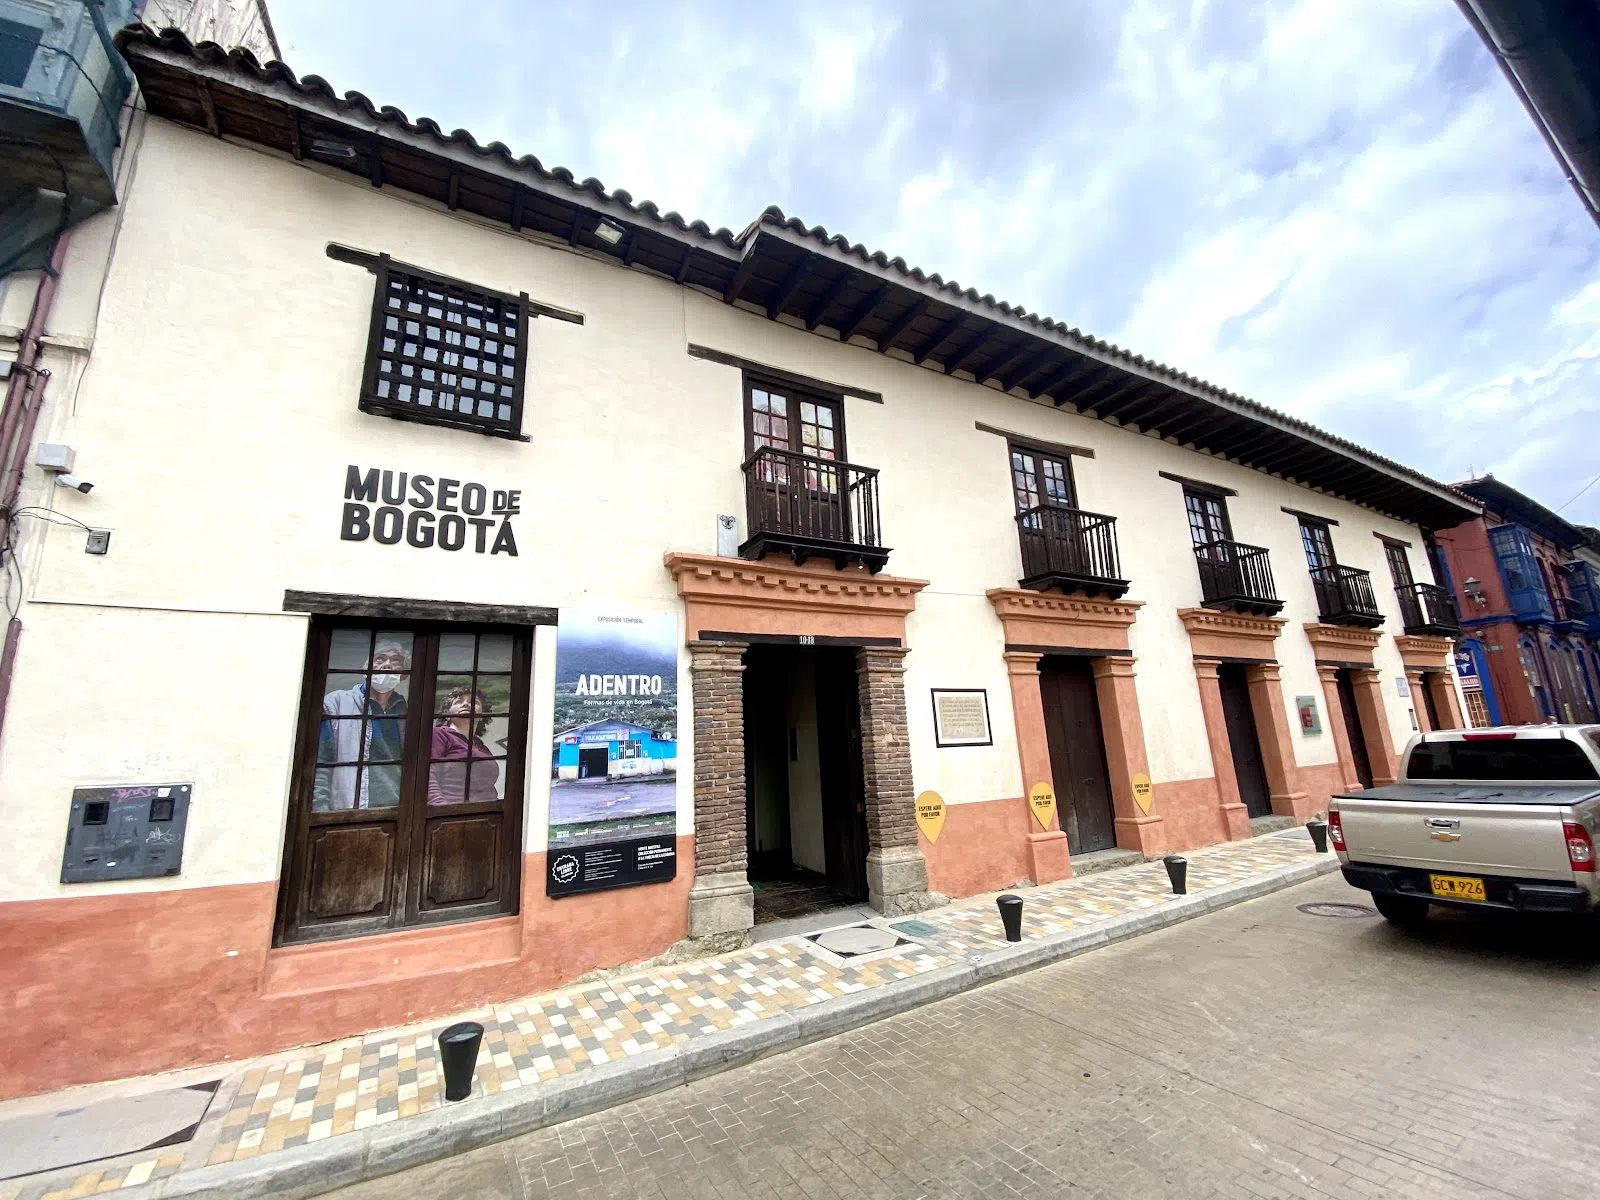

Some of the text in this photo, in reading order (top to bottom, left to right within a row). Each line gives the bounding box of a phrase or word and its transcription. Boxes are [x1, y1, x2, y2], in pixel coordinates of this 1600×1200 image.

[344, 464, 521, 516] MUSEO DE
[340, 502, 518, 557] BOGOTÁ
[575, 674, 662, 696] ADENTRO
[634, 699, 653, 707] Bogotá
[1459, 881, 1482, 894] 926
